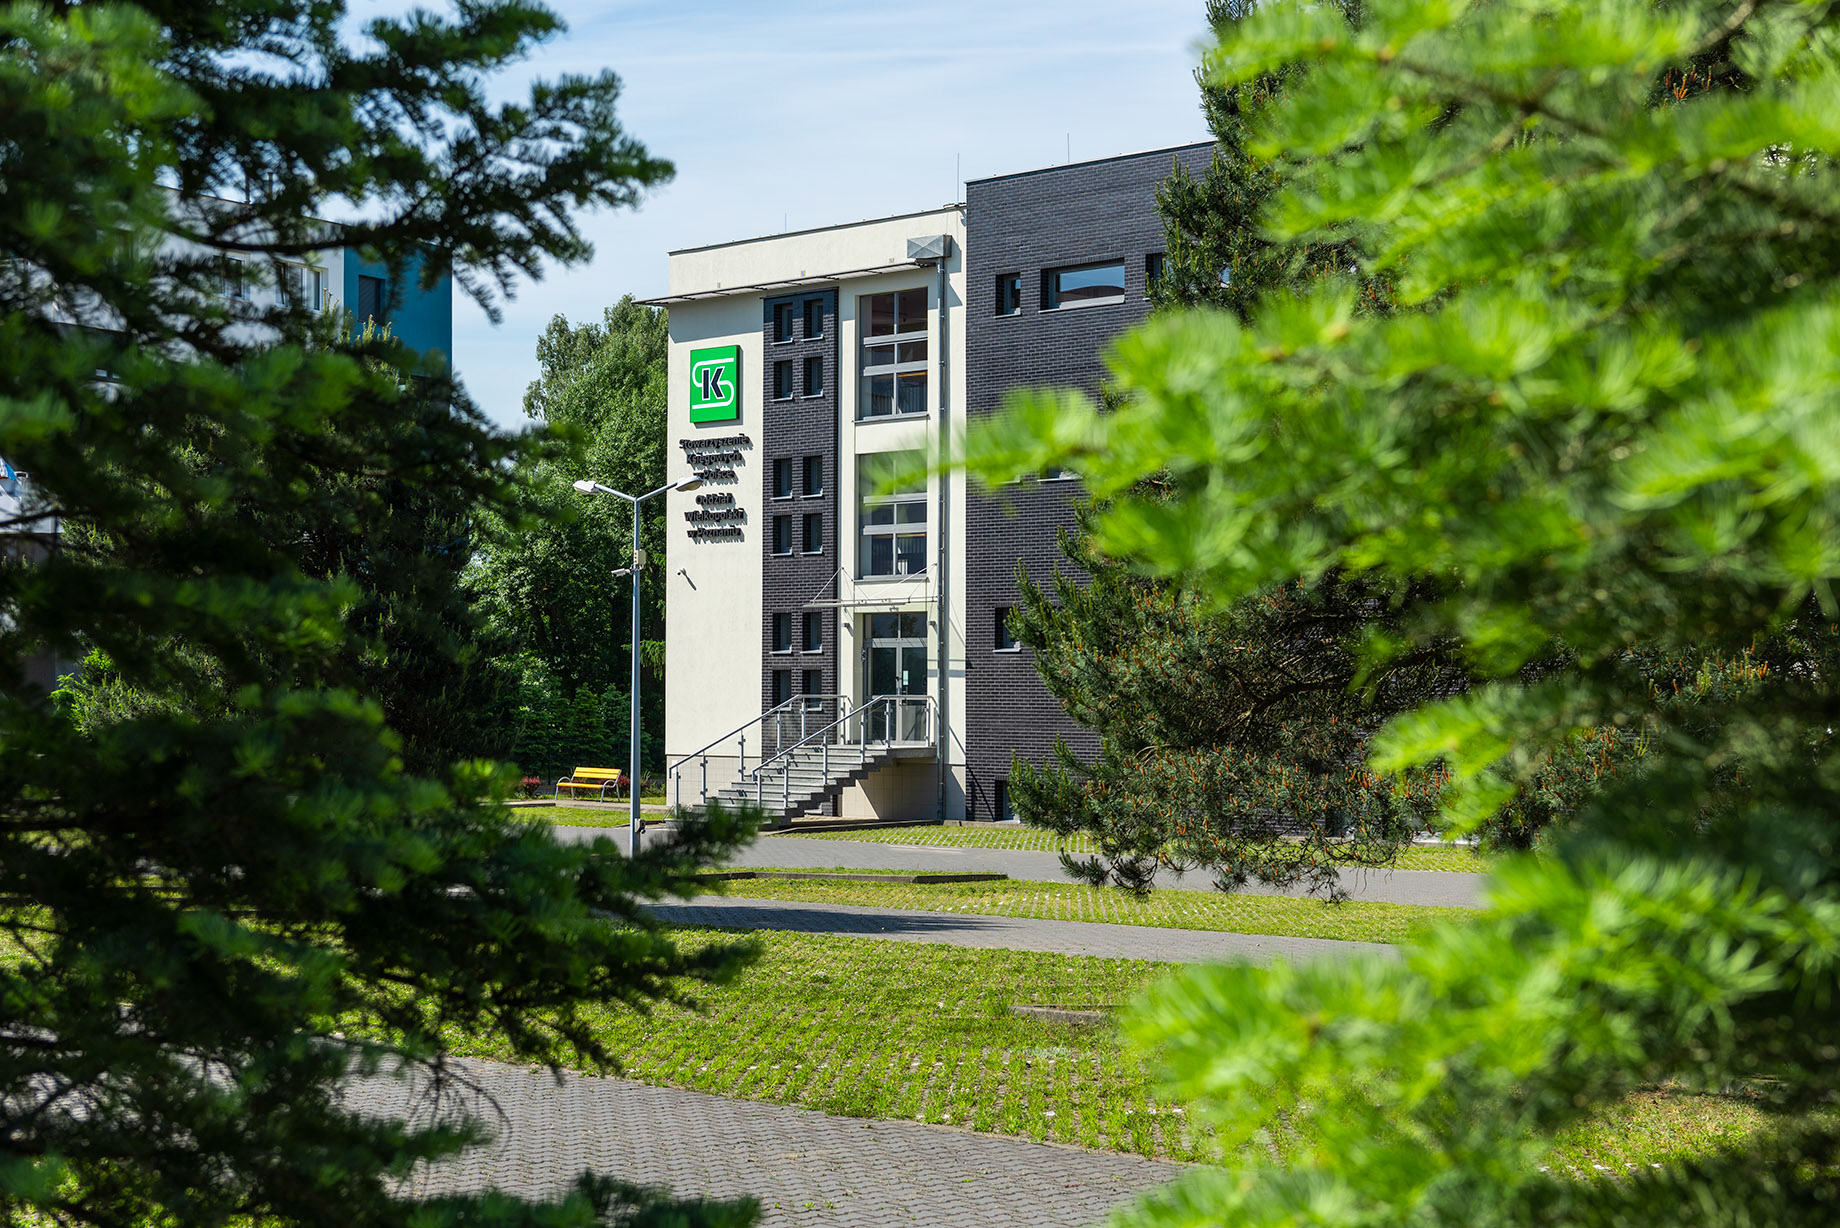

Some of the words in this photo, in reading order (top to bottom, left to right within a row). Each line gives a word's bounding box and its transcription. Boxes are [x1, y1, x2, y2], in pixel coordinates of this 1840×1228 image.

[679, 433, 750, 449] Stowarzyszenie
[687, 450, 742, 465] Księgowych
[703, 469, 735, 480] Polsce
[687, 530, 698, 538] w
[698, 525, 741, 538] Poznaniu
